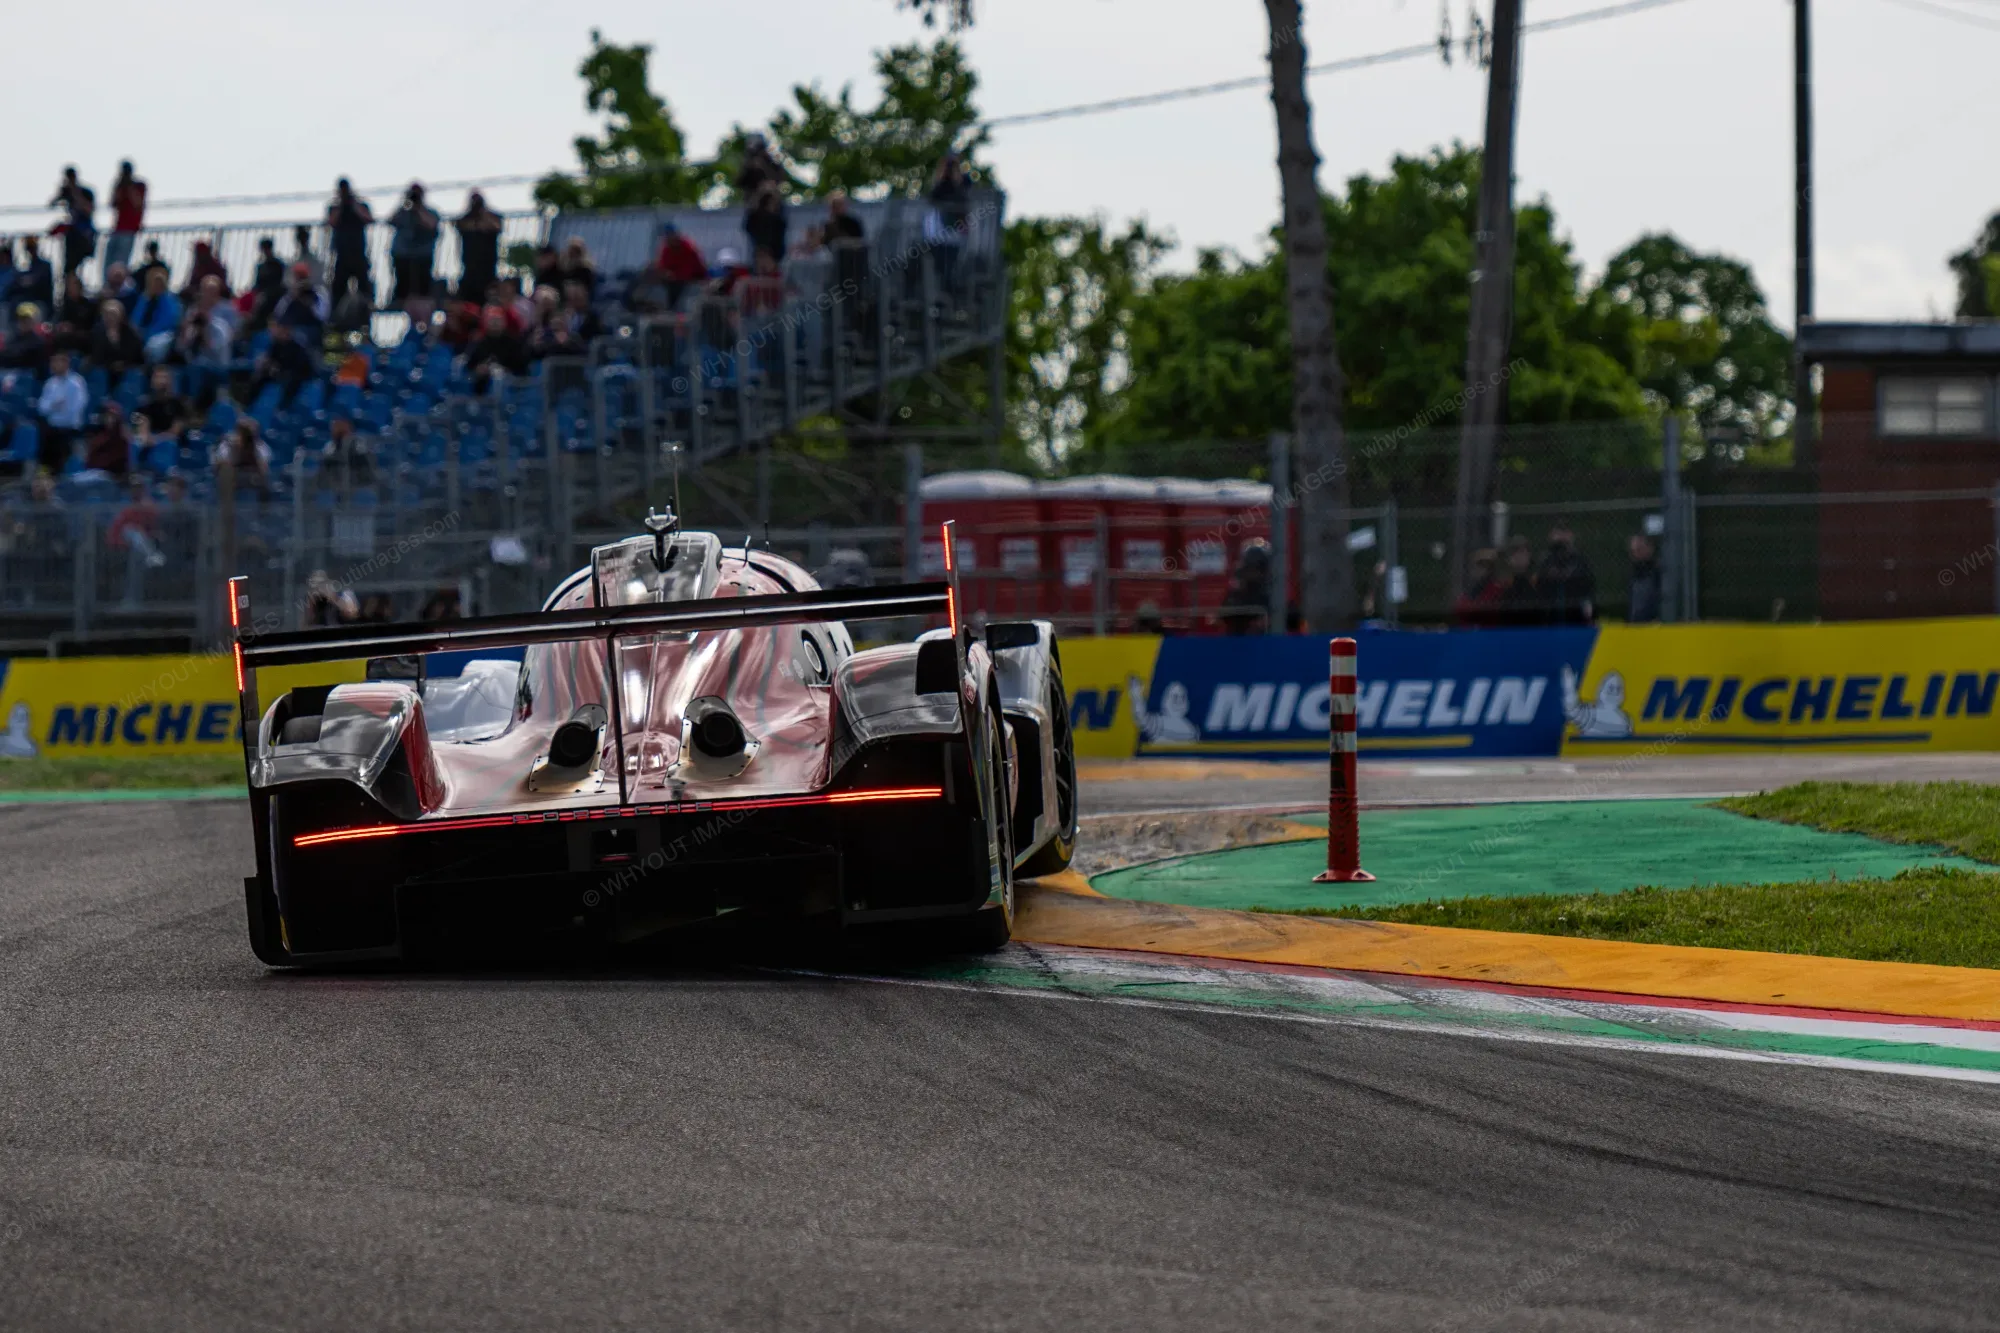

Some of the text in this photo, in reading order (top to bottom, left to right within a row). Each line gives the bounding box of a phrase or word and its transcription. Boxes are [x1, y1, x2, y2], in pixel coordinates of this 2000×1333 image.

[1205, 676, 1548, 732] MICHELIN
[1641, 671, 2000, 724] MICHELIN
[47, 702, 241, 746] MICHE
[512, 802, 712, 824] PORSCHE
